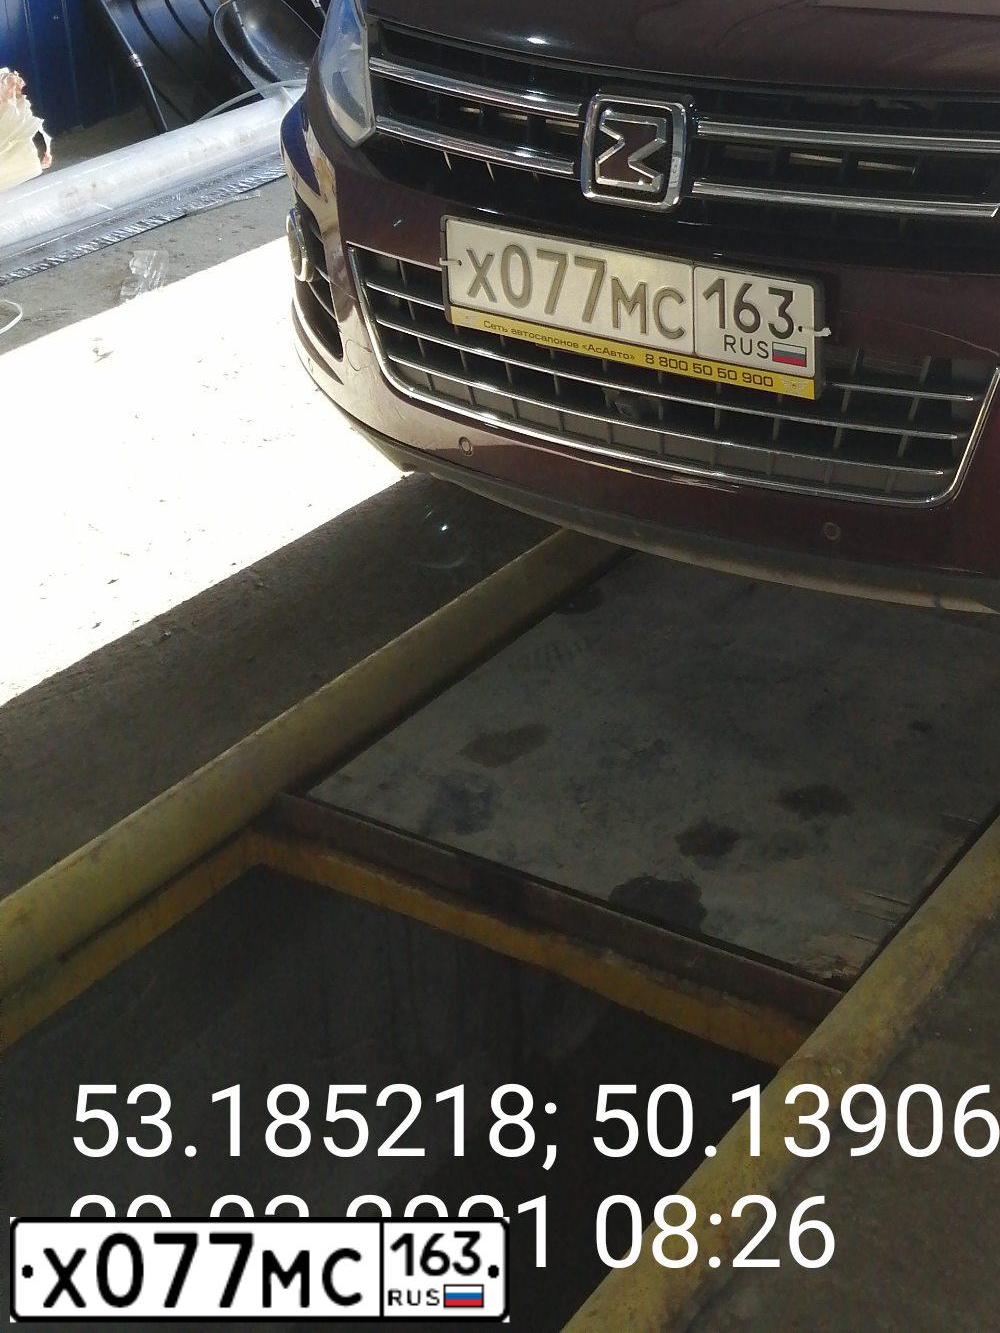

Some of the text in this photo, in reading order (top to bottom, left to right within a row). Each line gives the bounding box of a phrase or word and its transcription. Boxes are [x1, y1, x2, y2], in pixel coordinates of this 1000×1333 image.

[702, 277, 795, 340] 163
[483, 320, 508, 333] Сеть
[511, 329, 579, 349] автосалонов
[645, 354, 655, 365] 8
[659, 356, 688, 371] 800
[692, 363, 713, 376] 50
[717, 368, 738, 381] 50
[742, 372, 774, 387] 900
[723, 334, 769, 359] RUS
